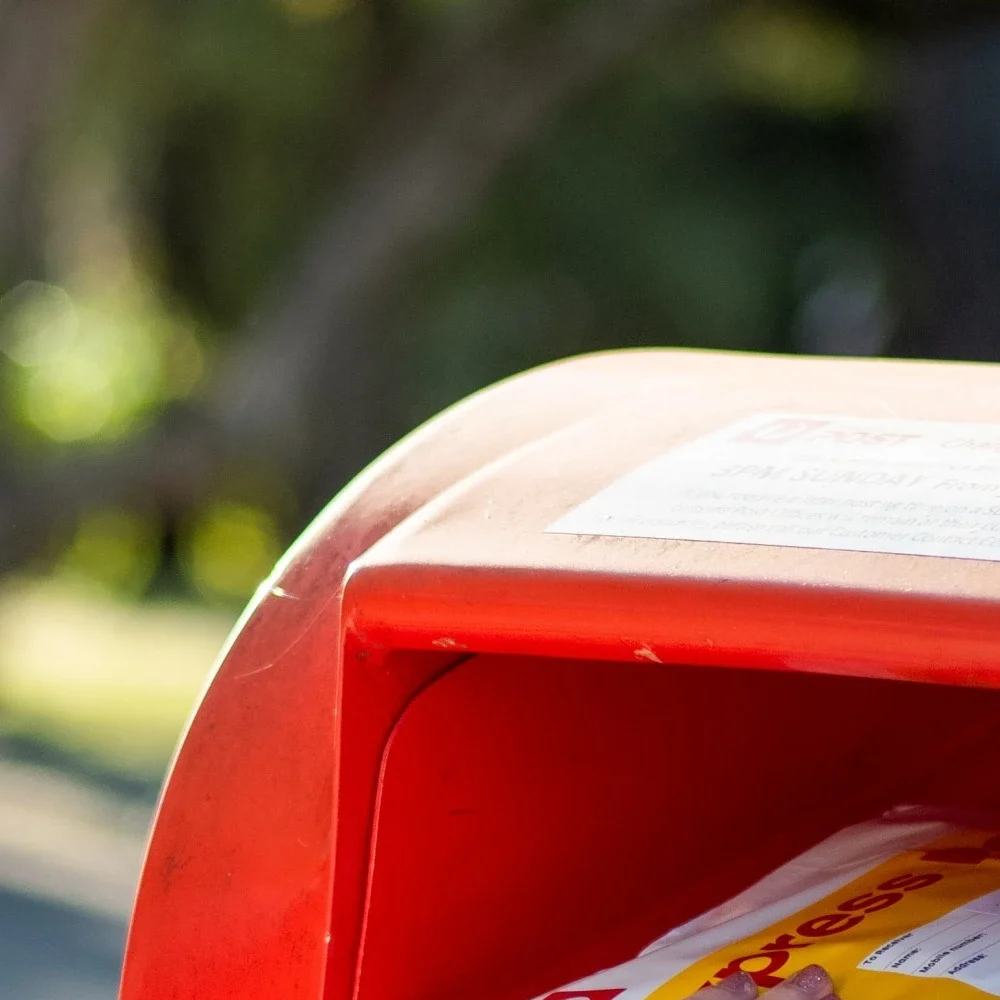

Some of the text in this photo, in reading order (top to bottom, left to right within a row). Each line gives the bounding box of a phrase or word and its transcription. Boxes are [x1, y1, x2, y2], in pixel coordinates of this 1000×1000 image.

[809, 430, 921, 445] POST
[788, 469, 926, 487] SUNDAY
[697, 872, 944, 989] press
[863, 954, 877, 965] To
[891, 947, 922, 969] Name:
[919, 932, 988, 974] Mobile number:
